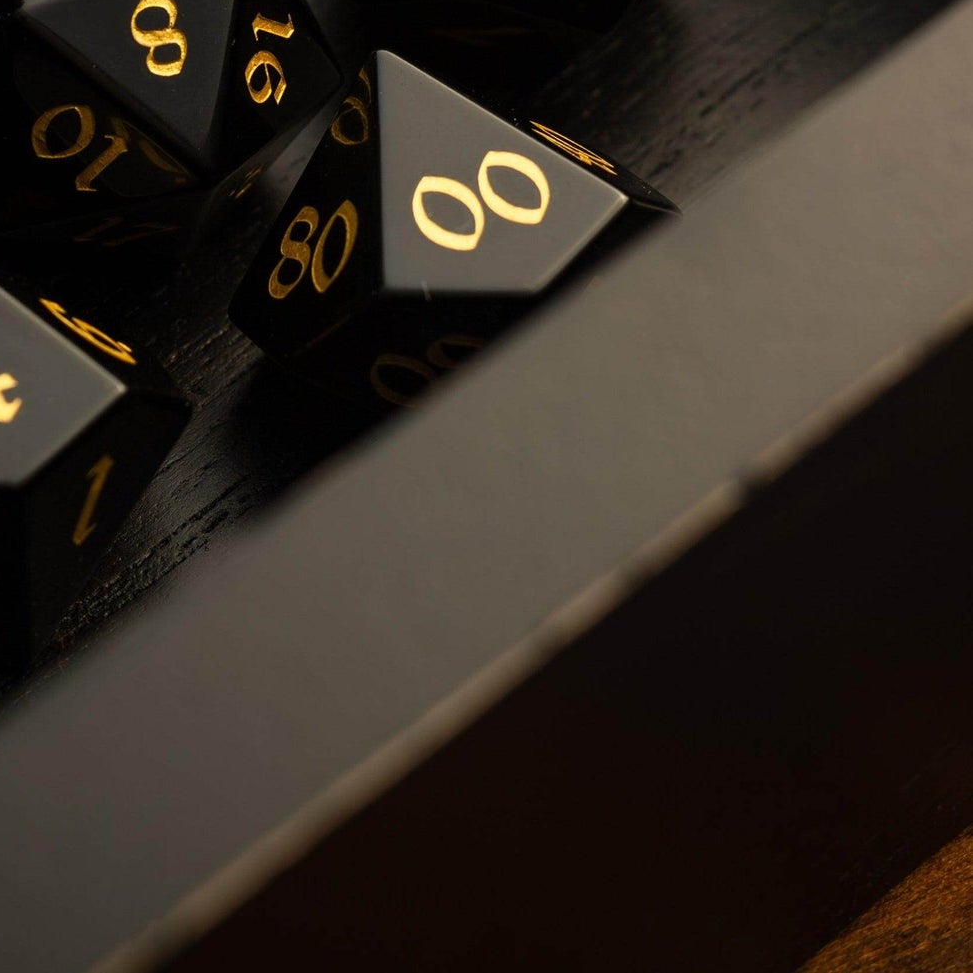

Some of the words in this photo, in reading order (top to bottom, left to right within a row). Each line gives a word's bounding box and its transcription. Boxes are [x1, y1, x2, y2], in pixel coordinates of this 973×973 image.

[244, 11, 295, 106] 16
[268, 200, 358, 299] 80
[411, 150, 552, 252] 00
[72, 454, 115, 547] 1
